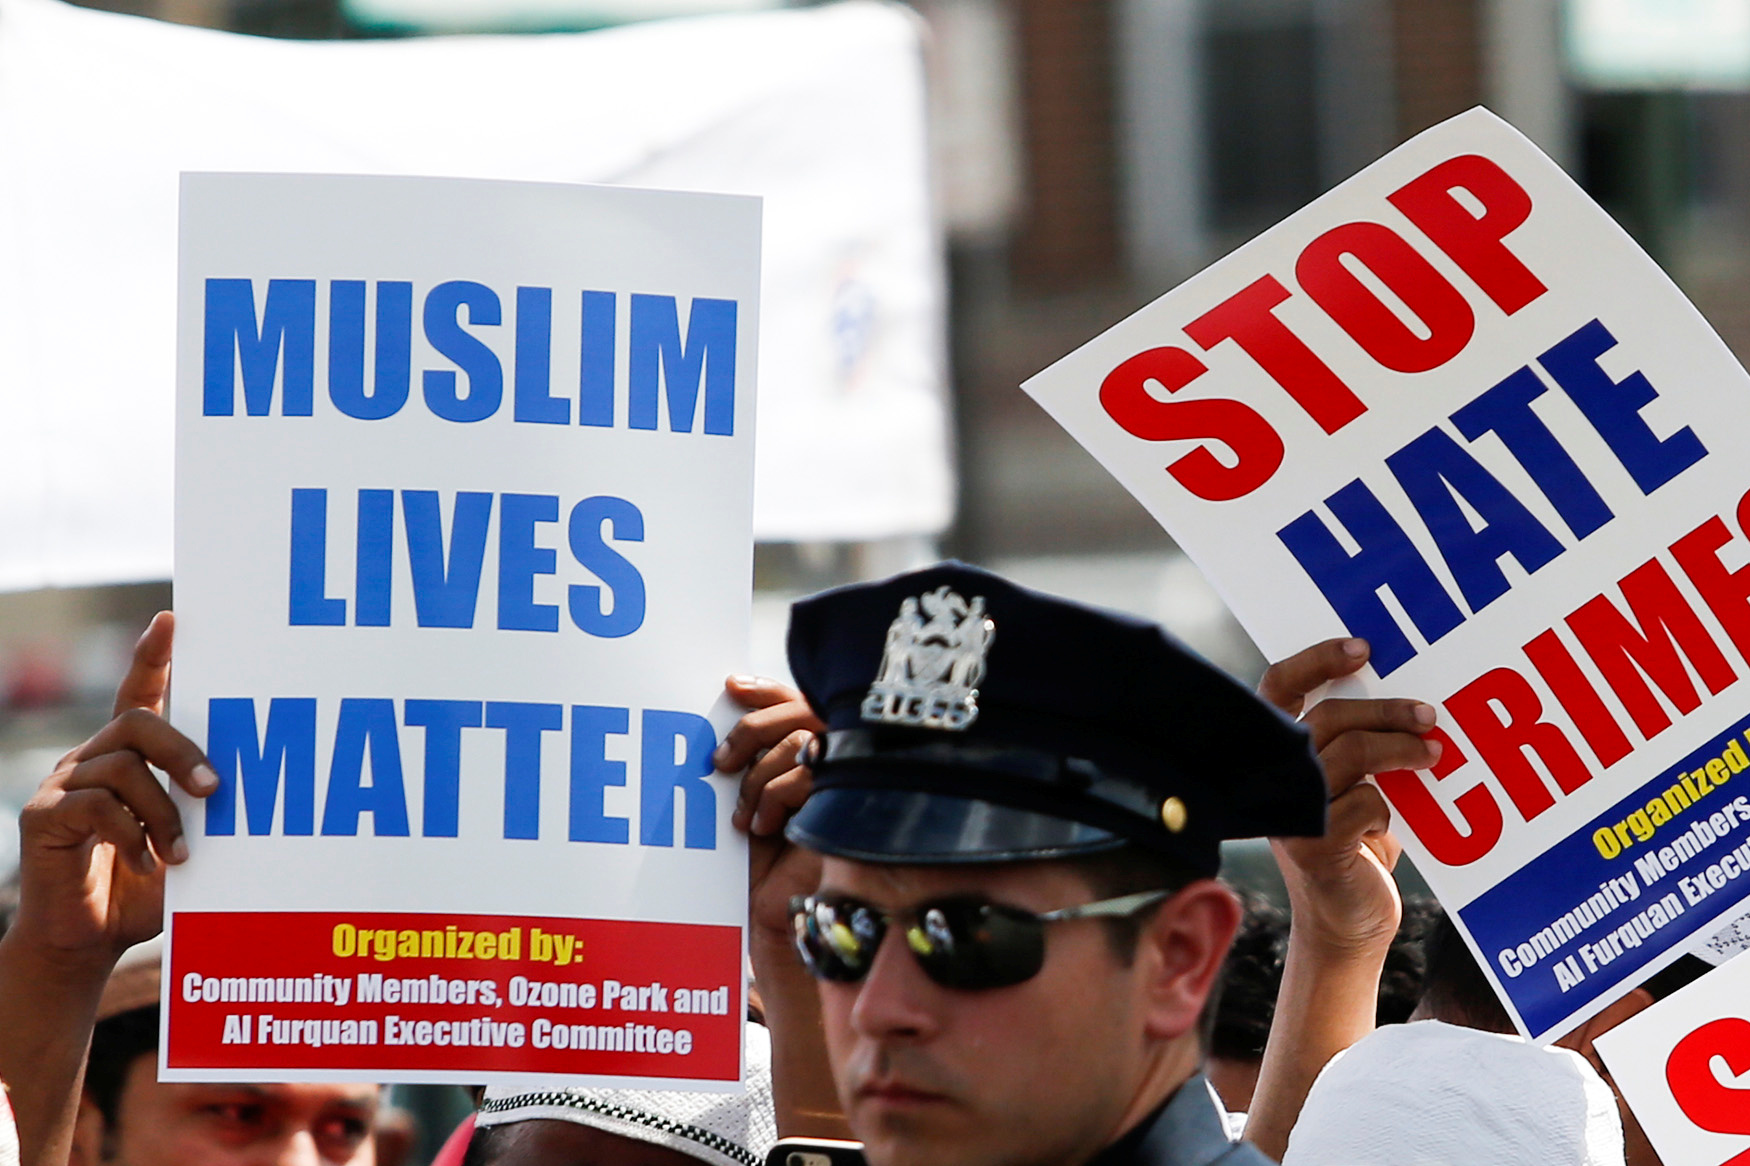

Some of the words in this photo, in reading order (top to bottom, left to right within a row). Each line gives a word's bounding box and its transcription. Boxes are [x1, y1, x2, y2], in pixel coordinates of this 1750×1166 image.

[203, 278, 737, 436] MUSLIM
[1100, 155, 1548, 501] STOP
[1276, 317, 1710, 681] HATE
[289, 489, 646, 638] LIVES
[205, 698, 717, 850] MATTER
[1592, 738, 1750, 861] Organized
[333, 924, 521, 960] Organized
[530, 928, 583, 965] by:
[1499, 871, 1640, 977] Community
[1552, 955, 1584, 993] Al
[1578, 893, 1684, 973] Furquan
[183, 973, 351, 1005] Community
[357, 974, 502, 1008] Members,
[509, 977, 596, 1008] Ozone
[603, 980, 668, 1012] Park
[674, 986, 728, 1015] and
[222, 1015, 251, 1044] Al
[258, 1015, 377, 1047] Furquan
[385, 1016, 525, 1047] Executive
[532, 1020, 692, 1054] Committee
